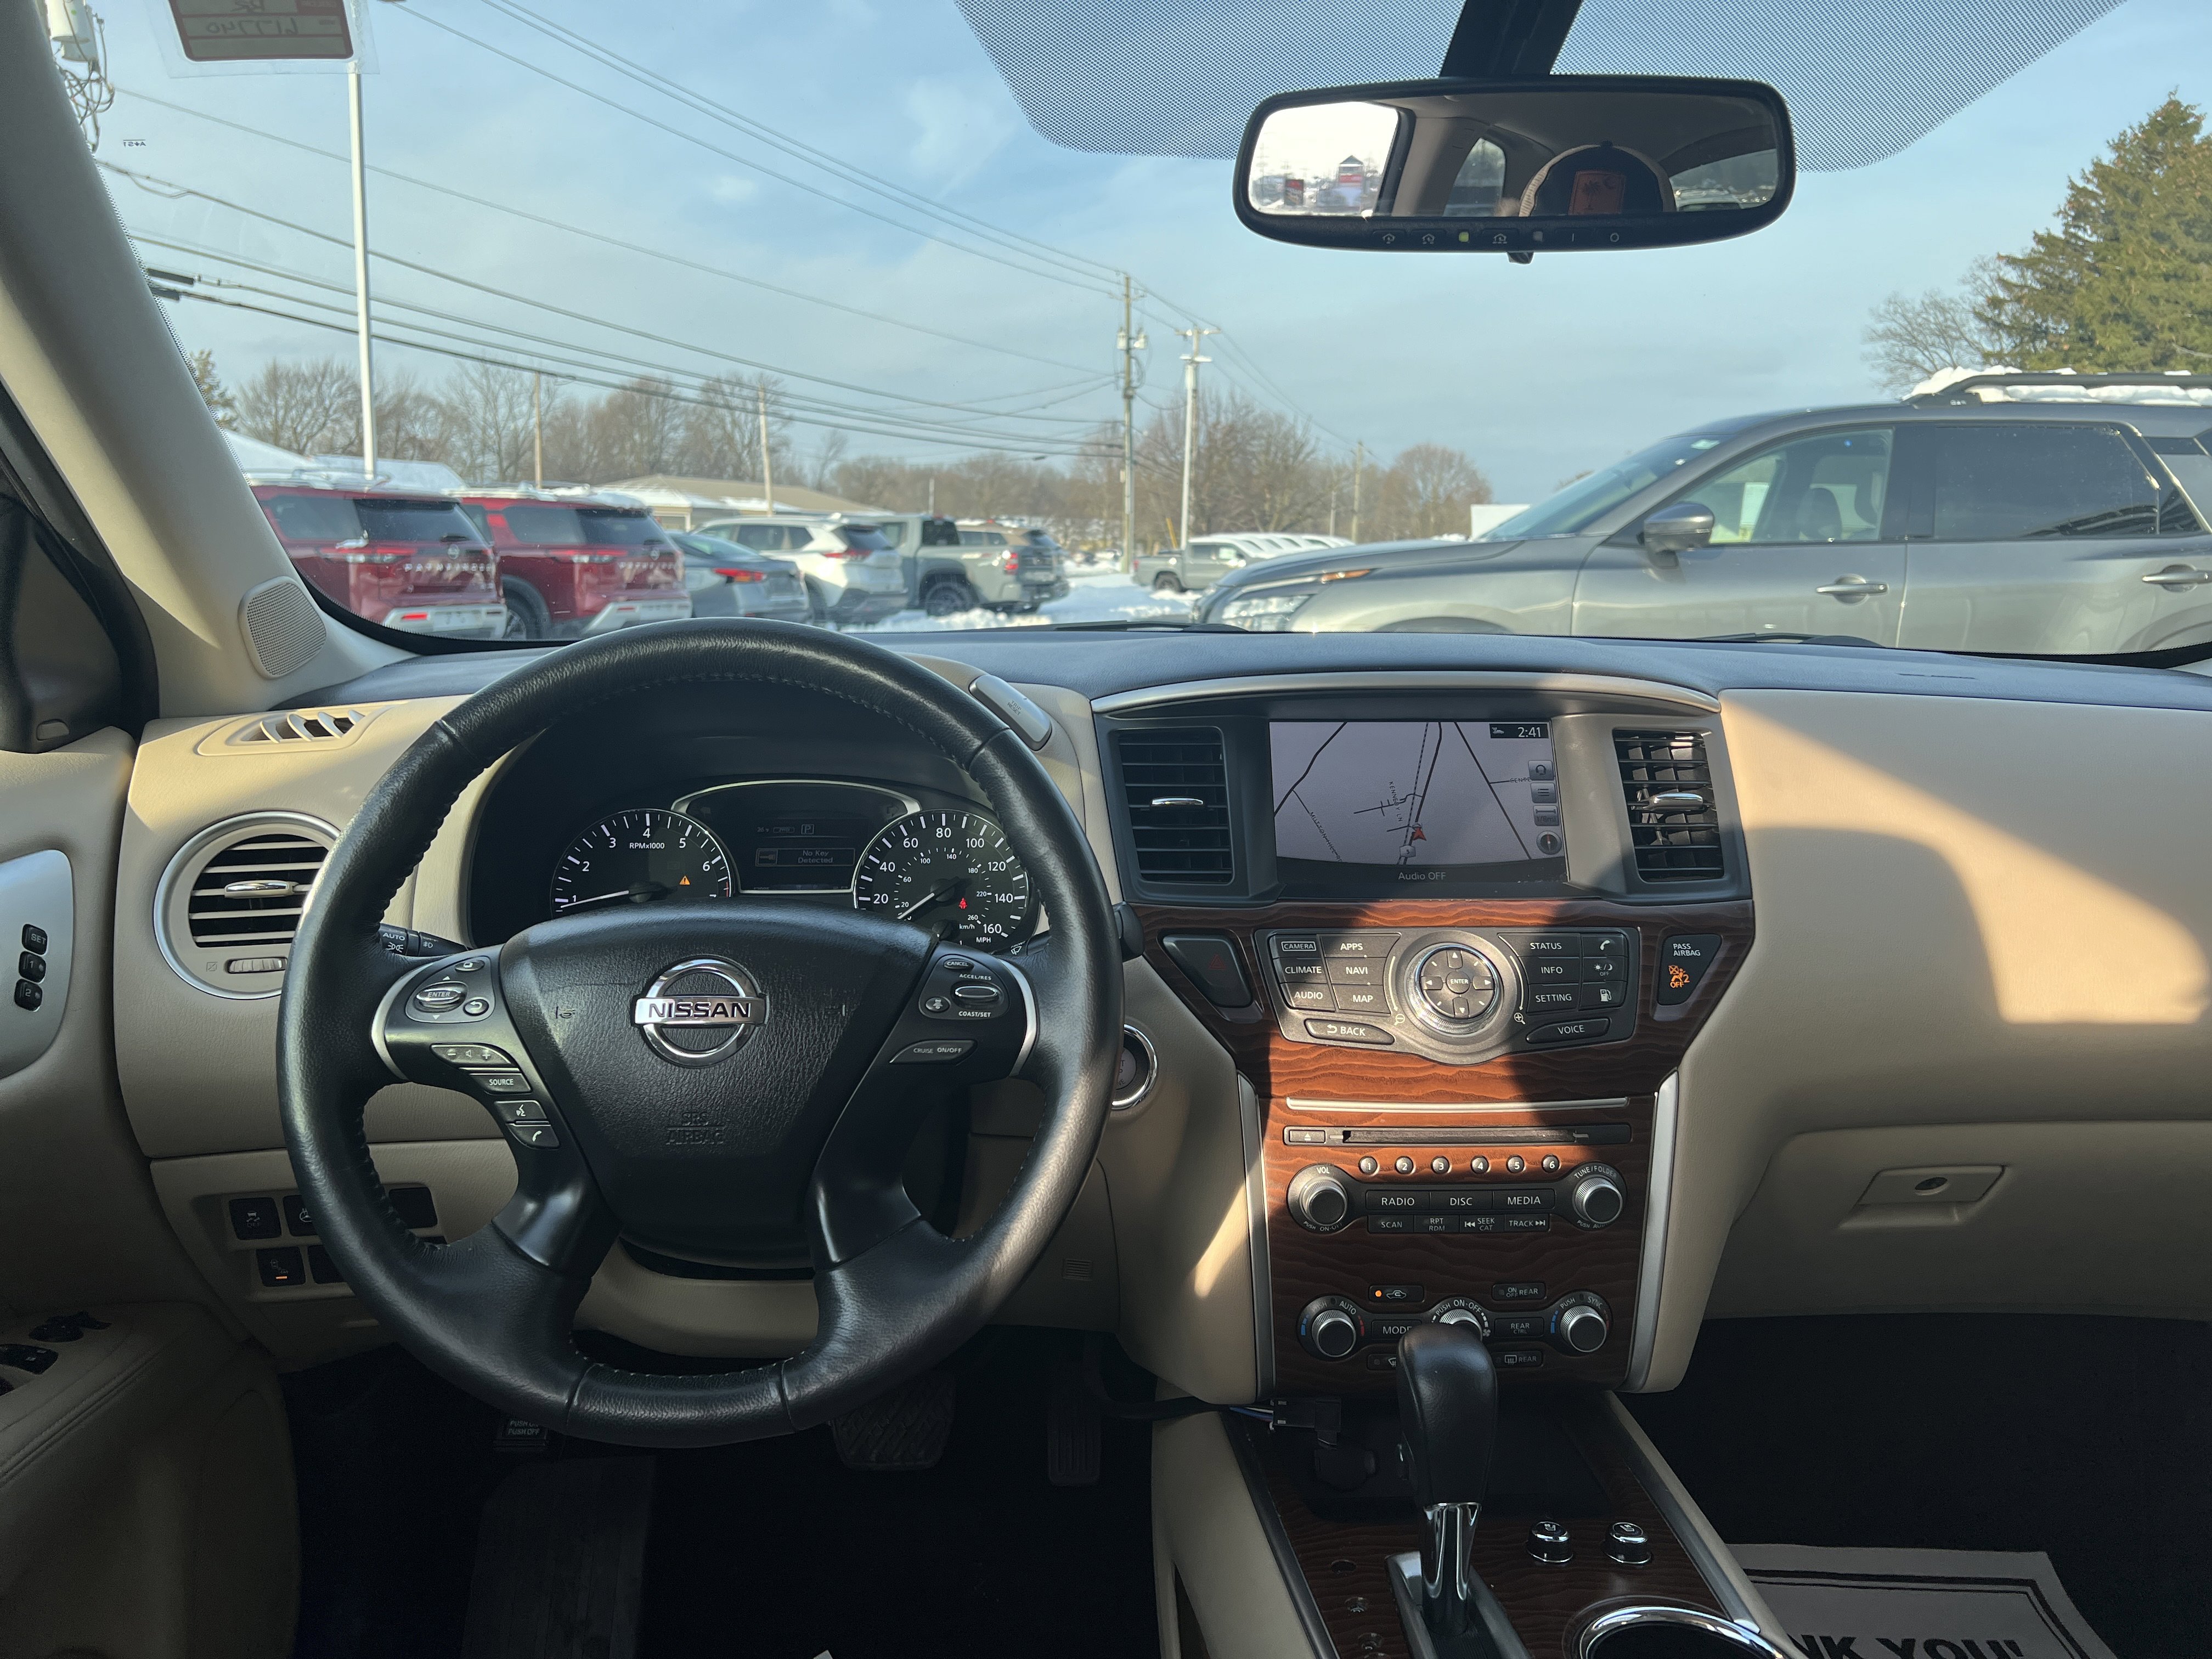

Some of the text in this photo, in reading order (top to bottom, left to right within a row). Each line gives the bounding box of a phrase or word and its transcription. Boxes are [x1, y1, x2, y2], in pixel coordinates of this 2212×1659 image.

[1517, 727, 1541, 737] 2:41
[642, 828, 651, 838] 4
[936, 827, 951, 838] 80
[609, 838, 616, 848] 3
[679, 838, 686, 848] 5
[904, 838, 918, 848] 60
[966, 838, 985, 848] 100
[582, 861, 590, 872] 2
[703, 861, 710, 871] 6
[879, 861, 895, 872] 40
[988, 861, 1006, 872] 120
[1398, 871, 1447, 880] Audio OFF
[873, 893, 889, 904] 20
[995, 893, 1013, 903] 140
[983, 924, 1002, 934] 160
[31, 933, 46, 945] SET
[383, 932, 405, 941] AUTO
[30, 961, 33, 969] 1
[25, 988, 31, 997] 2
[1294, 991, 1323, 1000] AUDIO
[1353, 995, 1373, 1003] MAP
[1536, 994, 1572, 1003] SETTING
[649, 1002, 751, 1018] NISSAN
[1340, 1026, 1366, 1036] BACK
[1558, 1025, 1585, 1034] VOICE
[1367, 1162, 1372, 1170] 1
[1401, 1162, 1408, 1170] 2
[1438, 1162, 1444, 1170] 3
[1477, 1162, 1483, 1170] 4
[1514, 1161, 1520, 1170] 5
[1549, 1161, 1555, 1169] 6
[1574, 1165, 1617, 1179] TUNE/FOLDER
[1381, 1197, 1415, 1206] RADIO
[1450, 1197, 1473, 1206] DISC
[1508, 1196, 1541, 1205] MEDIA
[1339, 1301, 1356, 1315] AUTO
[1560, 1296, 1603, 1310] PUSH SYNC
[1435, 1302, 1451, 1316] PUSH
